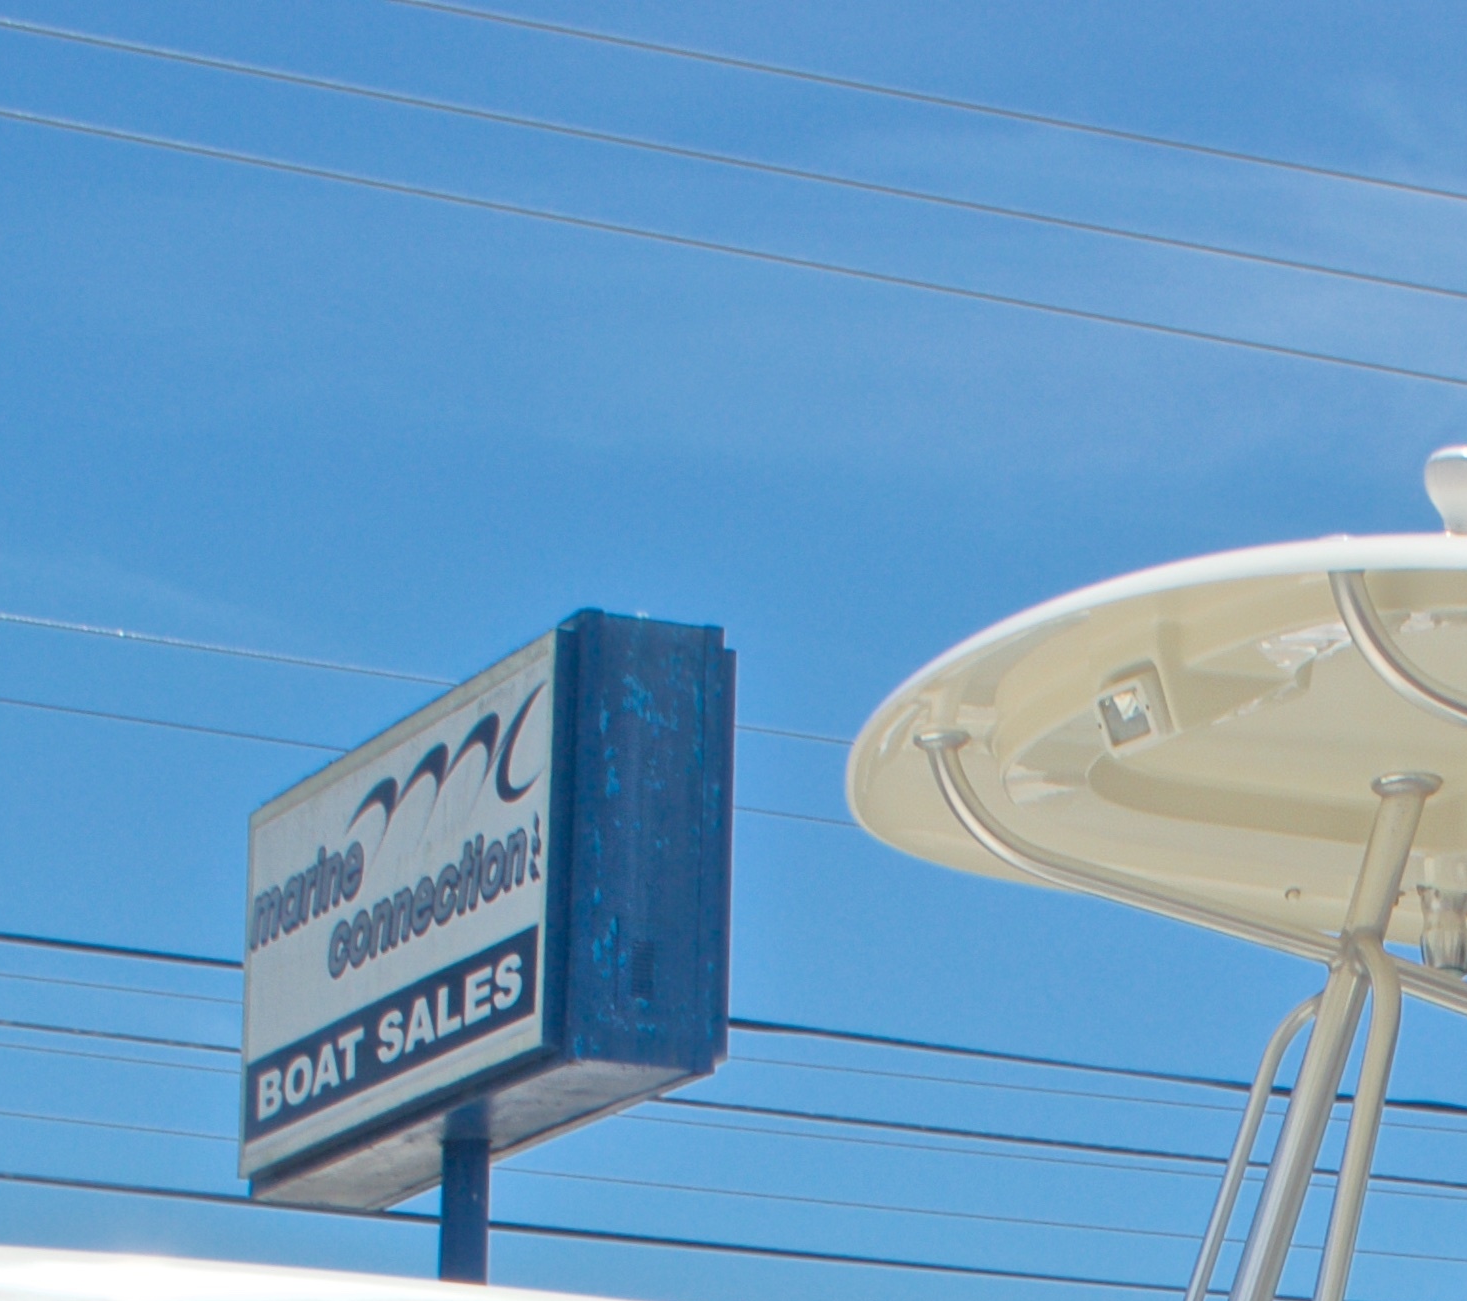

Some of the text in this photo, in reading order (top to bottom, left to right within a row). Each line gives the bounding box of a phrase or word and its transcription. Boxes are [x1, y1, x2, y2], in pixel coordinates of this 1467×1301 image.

[249, 840, 363, 952] marine
[328, 826, 526, 980] connection
[256, 955, 522, 1122] BOAT SALES
